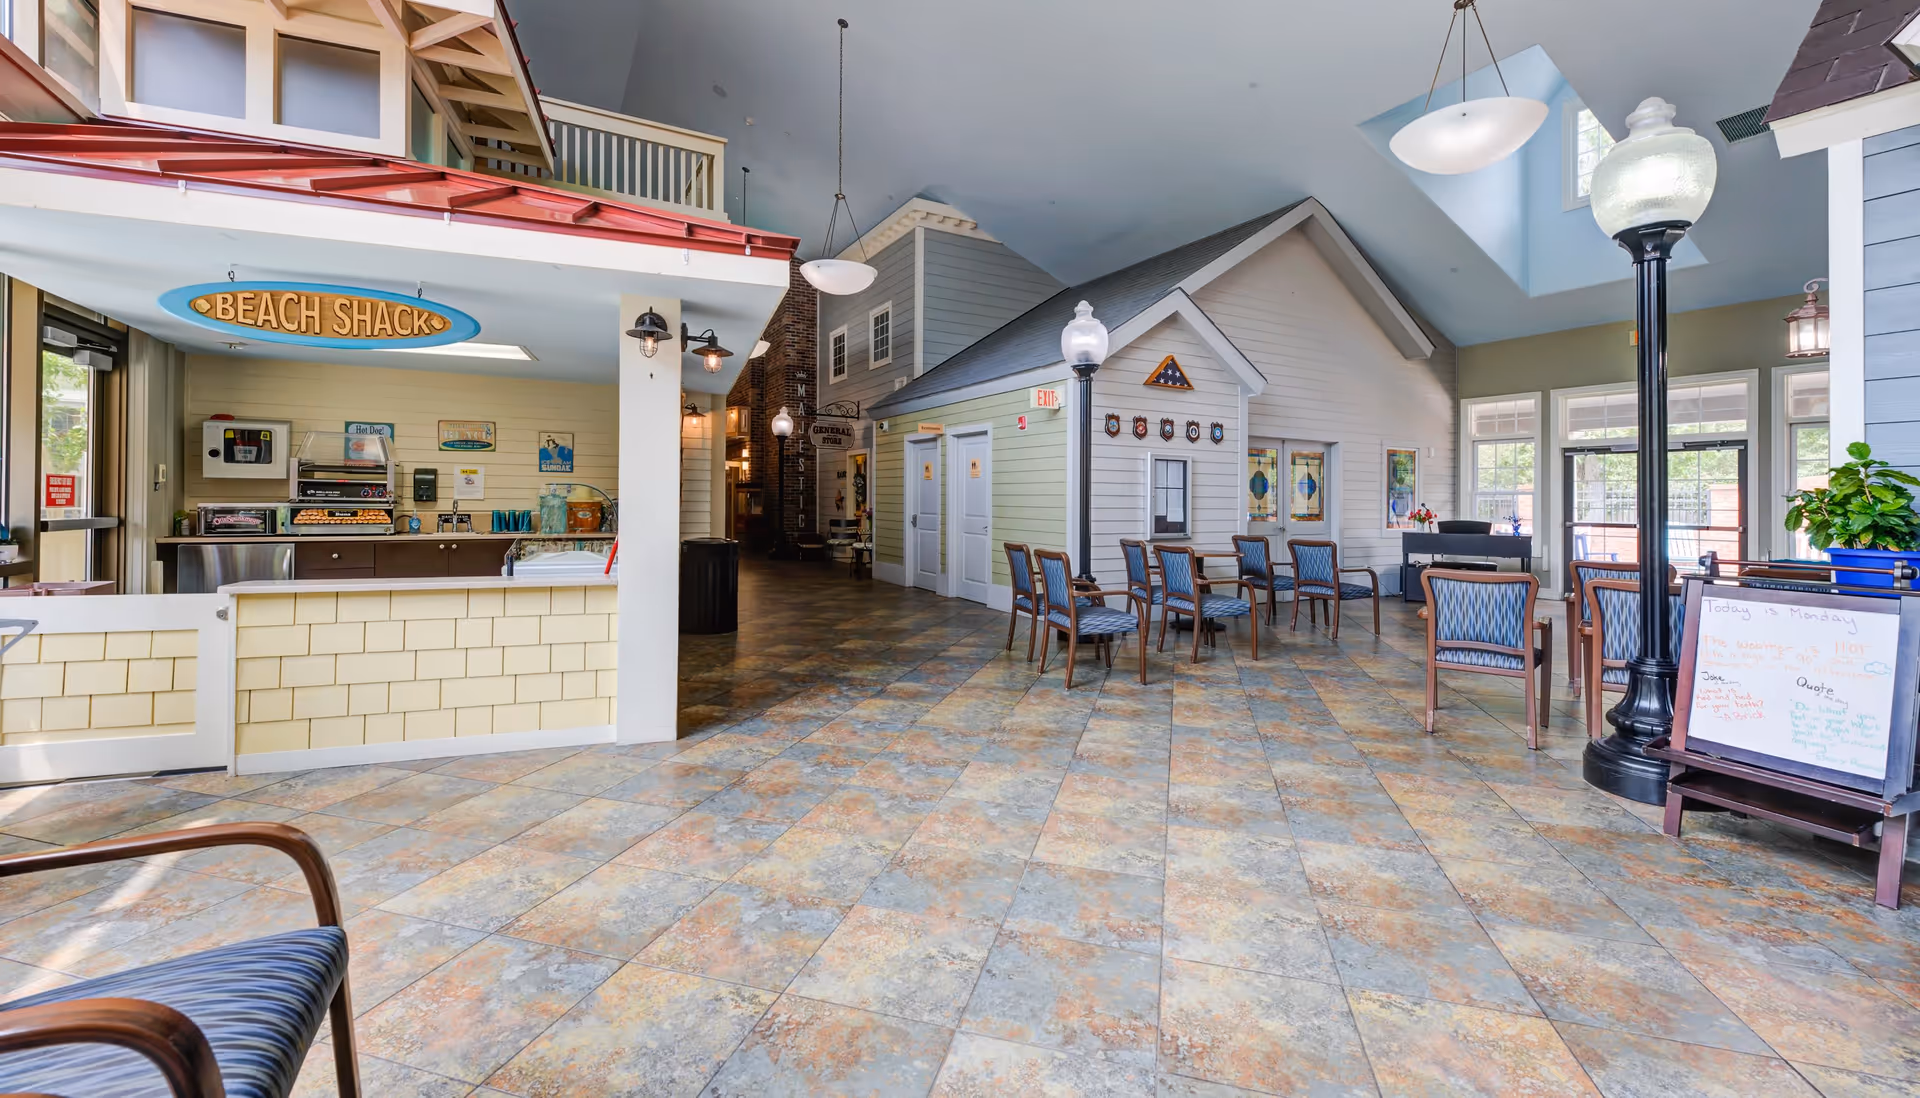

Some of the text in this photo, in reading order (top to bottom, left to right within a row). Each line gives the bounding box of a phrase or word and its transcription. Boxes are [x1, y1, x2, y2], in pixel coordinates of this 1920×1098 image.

[215, 292, 431, 337] BEACH SHACK
[1037, 389, 1055, 407] EXIT
[356, 425, 385, 435] Hot Dog!
[813, 425, 852, 437] GENERAL
[821, 436, 842, 445] STORE
[797, 383, 806, 528] MAJESTIC
[541, 464, 571, 472] SUNDAE
[1703, 599, 1858, 635] Today is Monday
[1701, 671, 1725, 681] Joke
[1796, 676, 1835, 695] Quote
